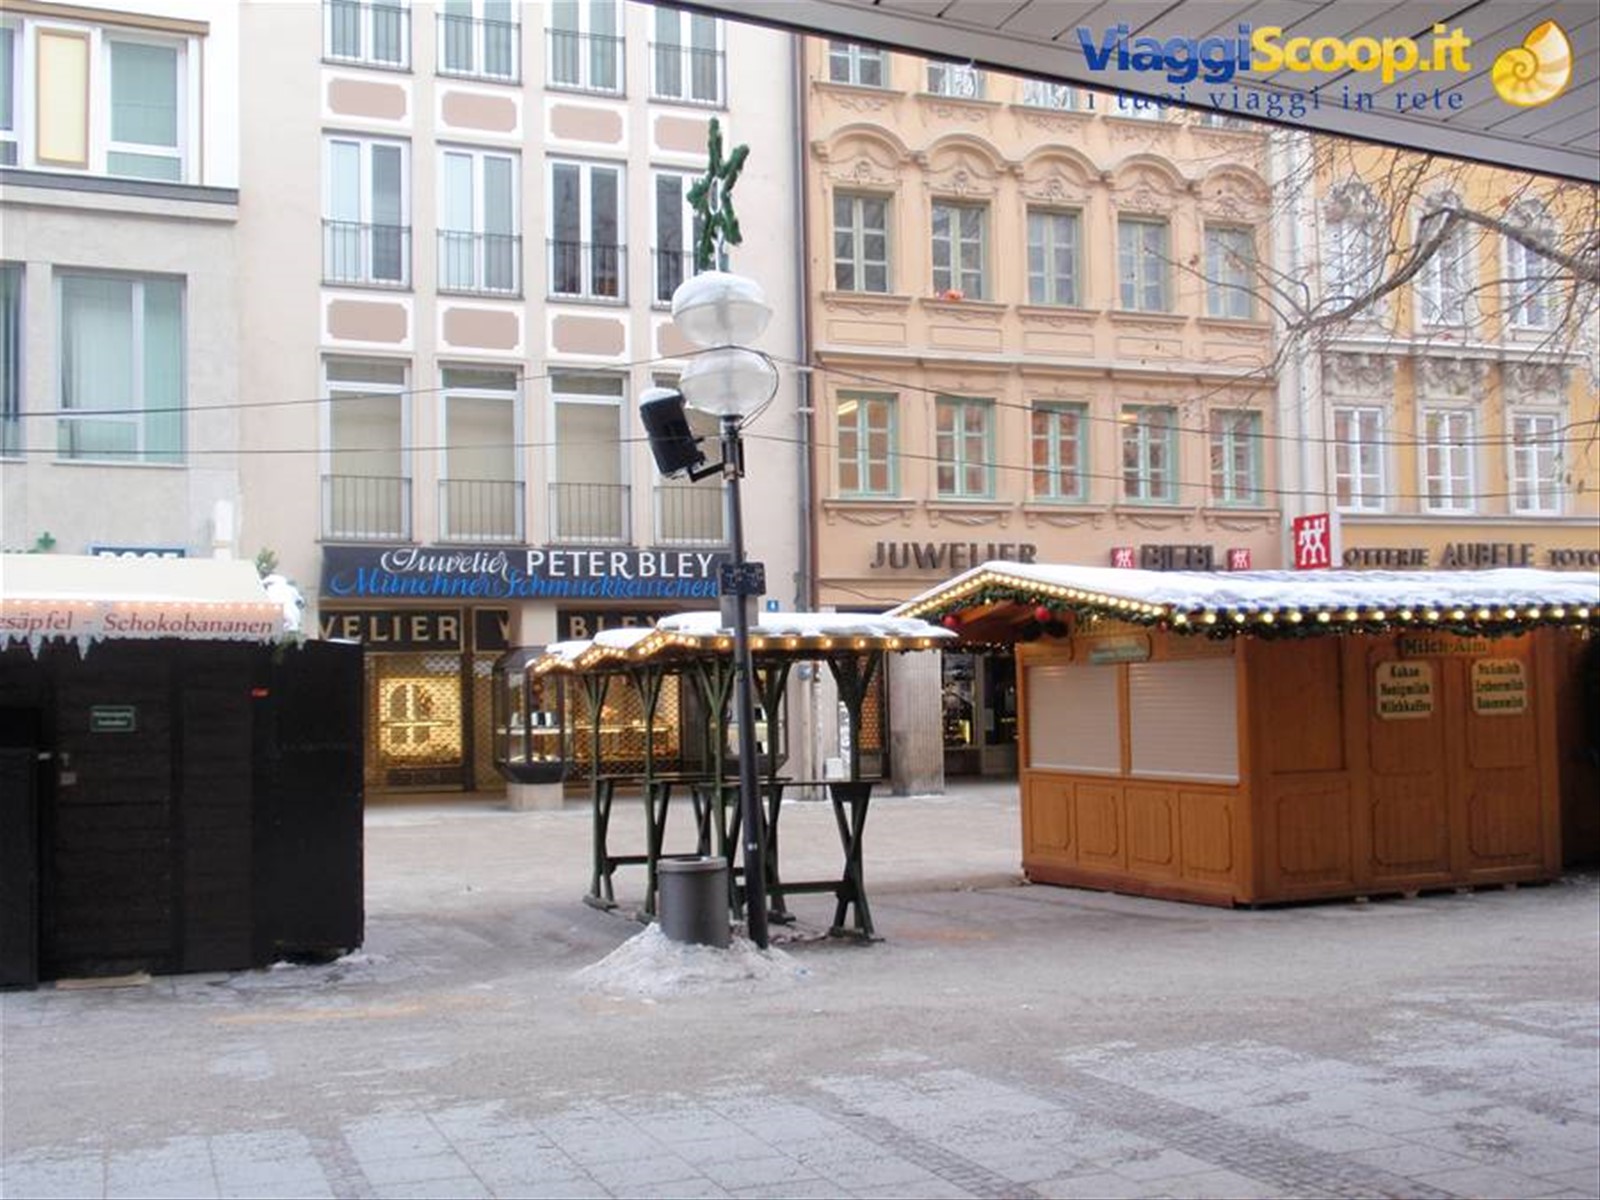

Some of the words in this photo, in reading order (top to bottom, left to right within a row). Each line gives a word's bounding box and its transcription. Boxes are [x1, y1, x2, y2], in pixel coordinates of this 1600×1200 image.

[380, 548, 524, 583] Juwelier
[526, 550, 636, 580] PETER
[638, 551, 714, 578] BLEY
[870, 542, 1037, 569] JUWELIER
[103, 614, 273, 634] Schokobananen
